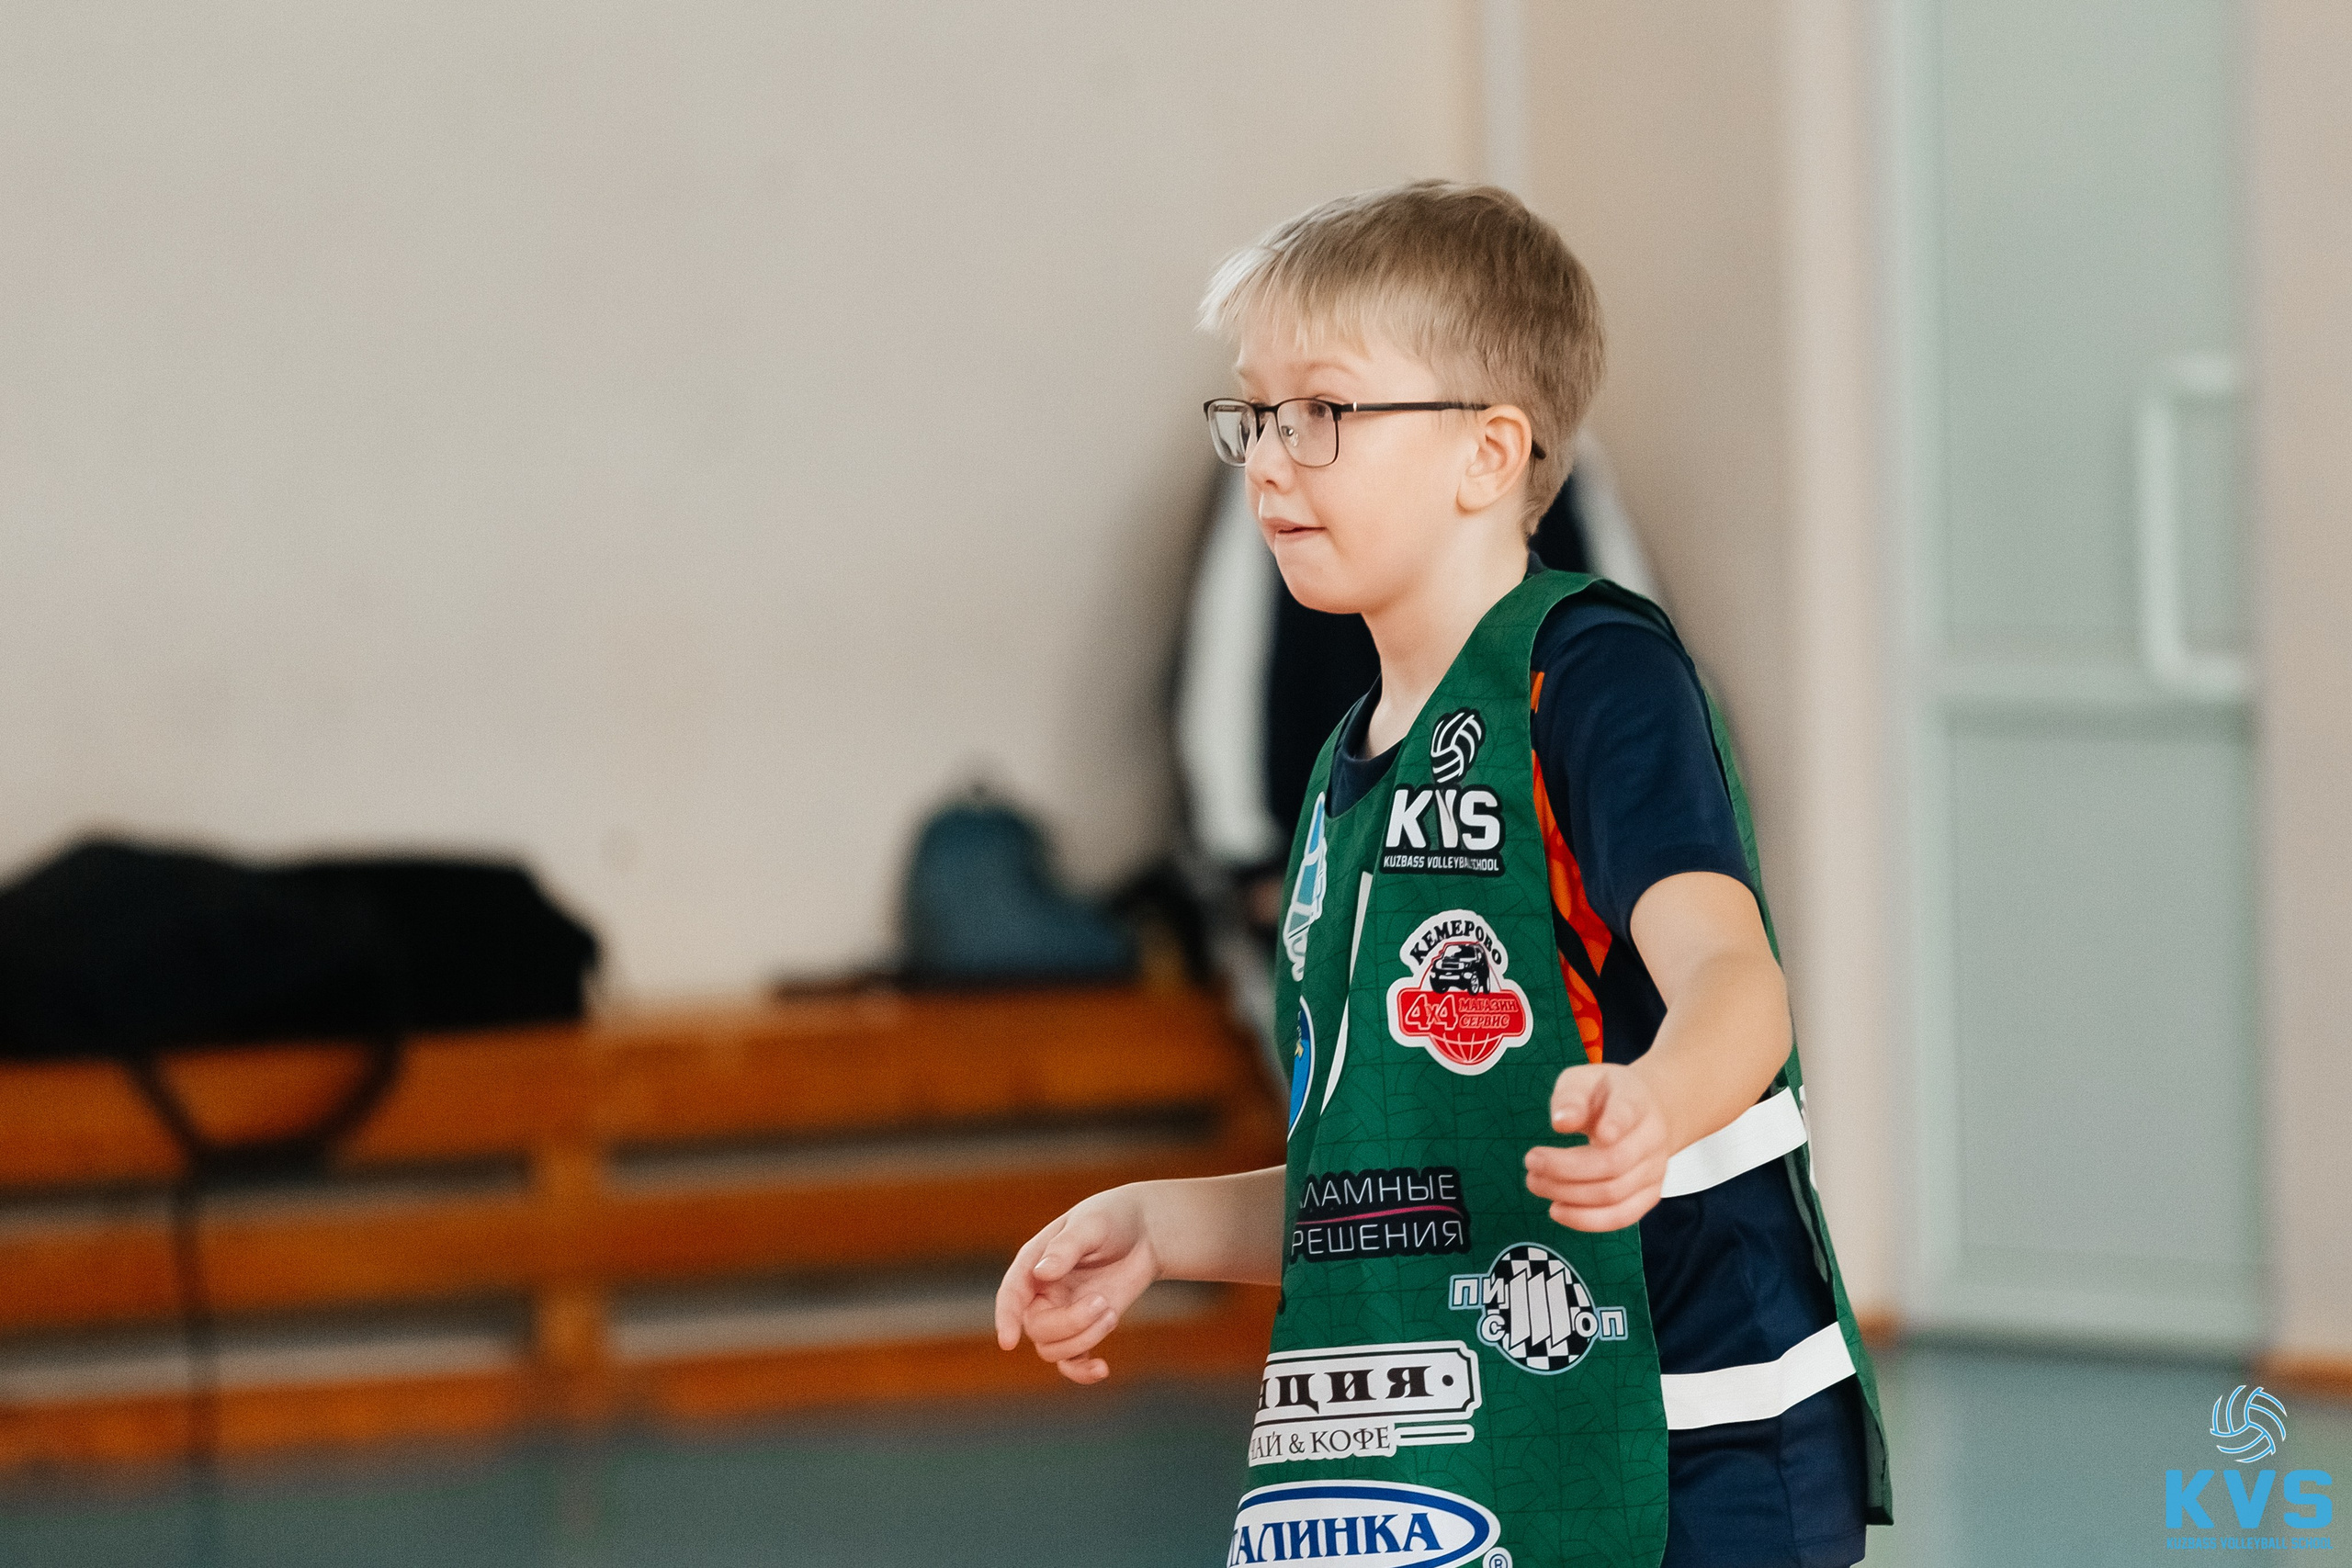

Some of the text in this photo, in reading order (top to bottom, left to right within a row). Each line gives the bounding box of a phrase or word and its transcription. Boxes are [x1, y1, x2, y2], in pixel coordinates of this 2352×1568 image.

[1383, 855, 1425, 868] KUZBASS
[1409, 919, 1502, 965] КЕМЕРОВО
[1458, 998, 1519, 1012] МАГАЗИН
[1459, 1014, 1510, 1029] СЕРВИС
[1300, 1174, 1457, 1209] ЛАМНЫЕ
[1291, 1220, 1464, 1257] РЕШЕНИЯ
[1309, 1426, 1391, 1454] КОФЕ
